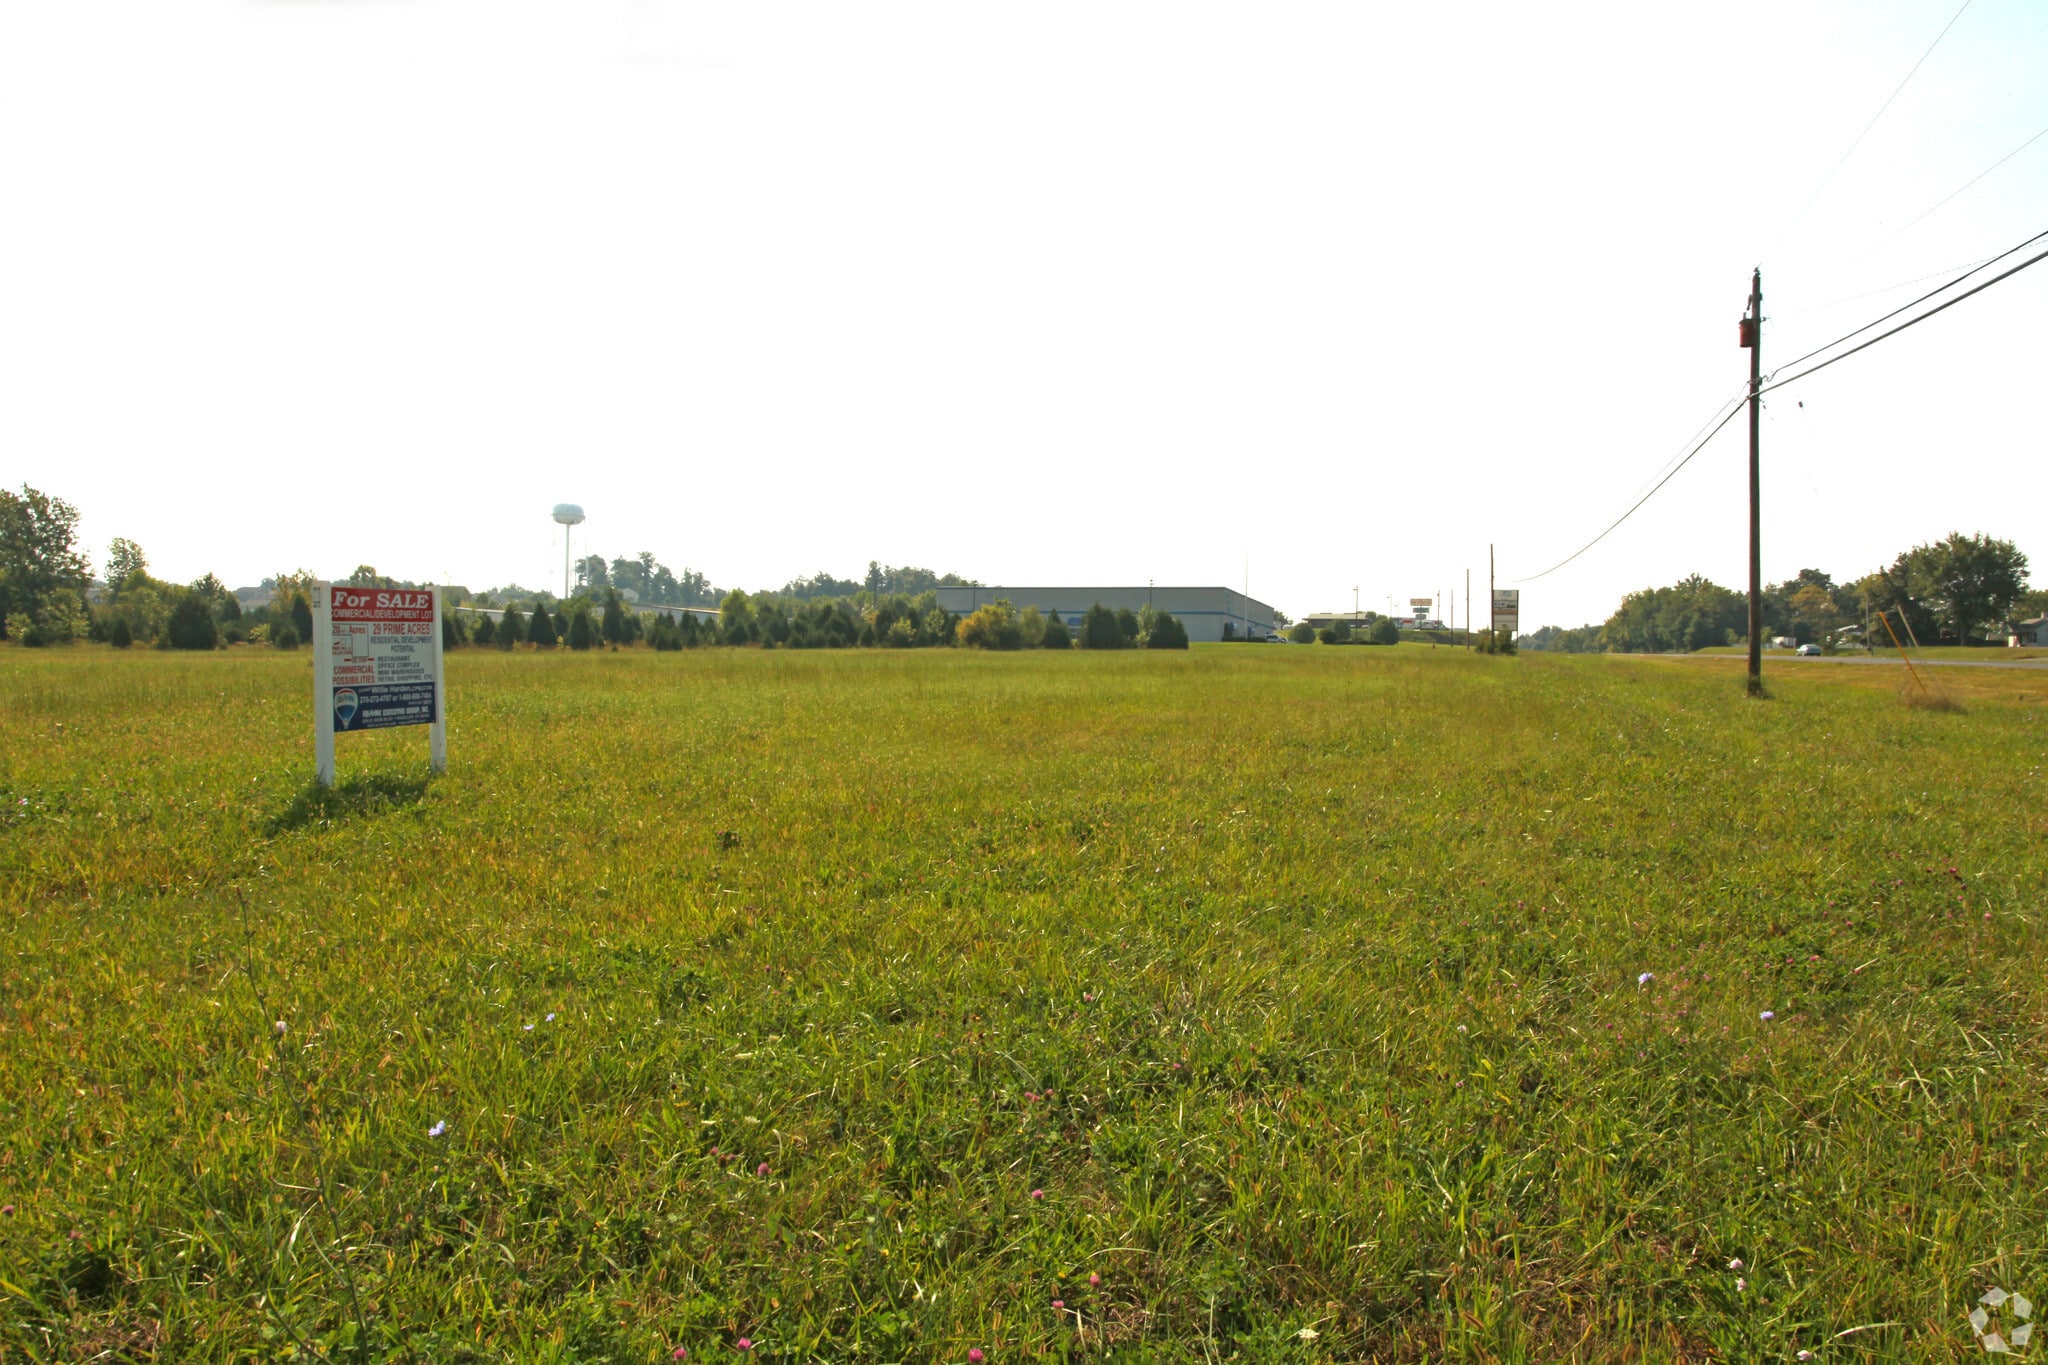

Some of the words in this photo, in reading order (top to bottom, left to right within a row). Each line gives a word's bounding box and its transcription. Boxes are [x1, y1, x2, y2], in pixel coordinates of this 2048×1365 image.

[332, 591, 370, 607] For
[376, 593, 429, 608] SALE
[384, 624, 405, 635] PRIME
[407, 624, 430, 635] ACRES
[370, 636, 400, 644] RESIDENTIAL
[334, 666, 374, 675] COMMERCIAL
[332, 675, 375, 685] POSSIBILITIES
